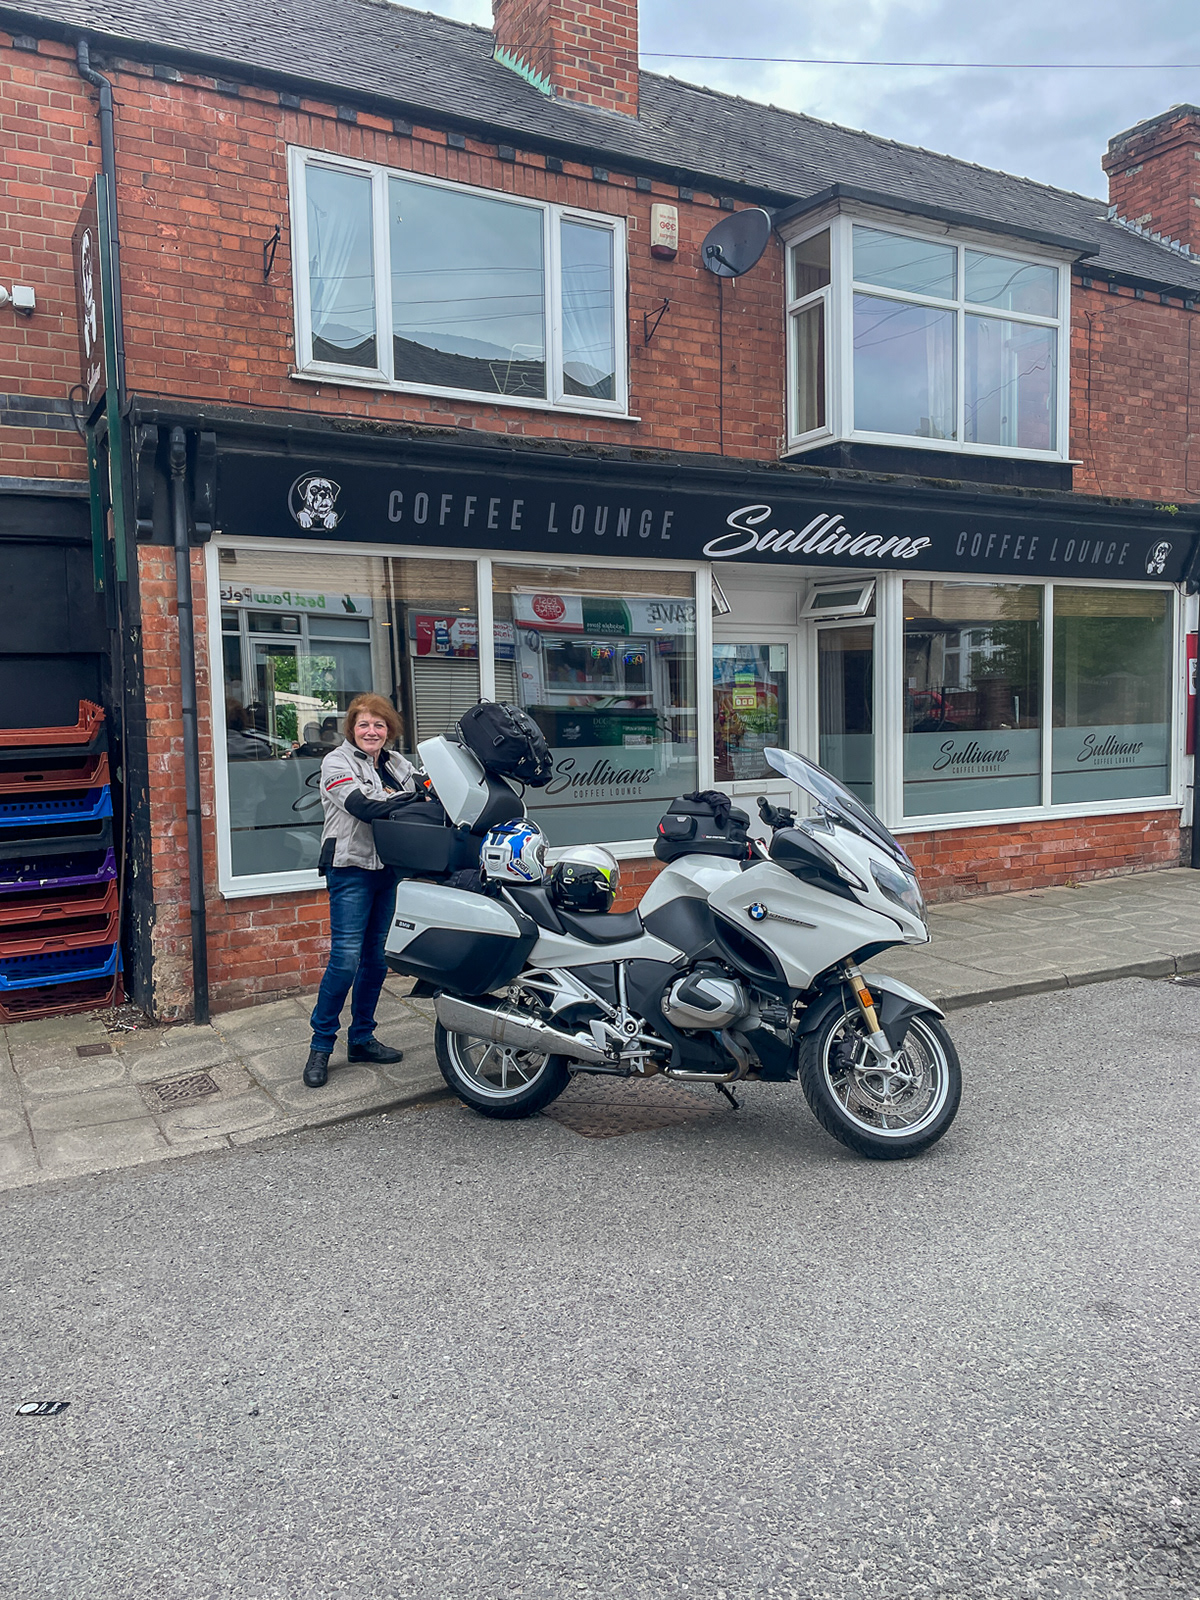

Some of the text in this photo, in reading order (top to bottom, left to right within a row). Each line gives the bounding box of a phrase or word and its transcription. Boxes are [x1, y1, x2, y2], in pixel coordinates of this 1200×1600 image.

[388, 490, 674, 539] COFFEE LOUNGE
[703, 504, 932, 558] Sullivans
[956, 531, 1131, 565] COFFEE LOUNGE
[932, 740, 1010, 771] Sullivans
[1077, 733, 1144, 762] Sullivans
[1093, 755, 1136, 765] COFFEE LOUNGE
[545, 757, 655, 795] Sullivans
[952, 764, 1000, 774] COFFEE LOUNGE
[573, 786, 643, 799] COFFEE LOUNGE
